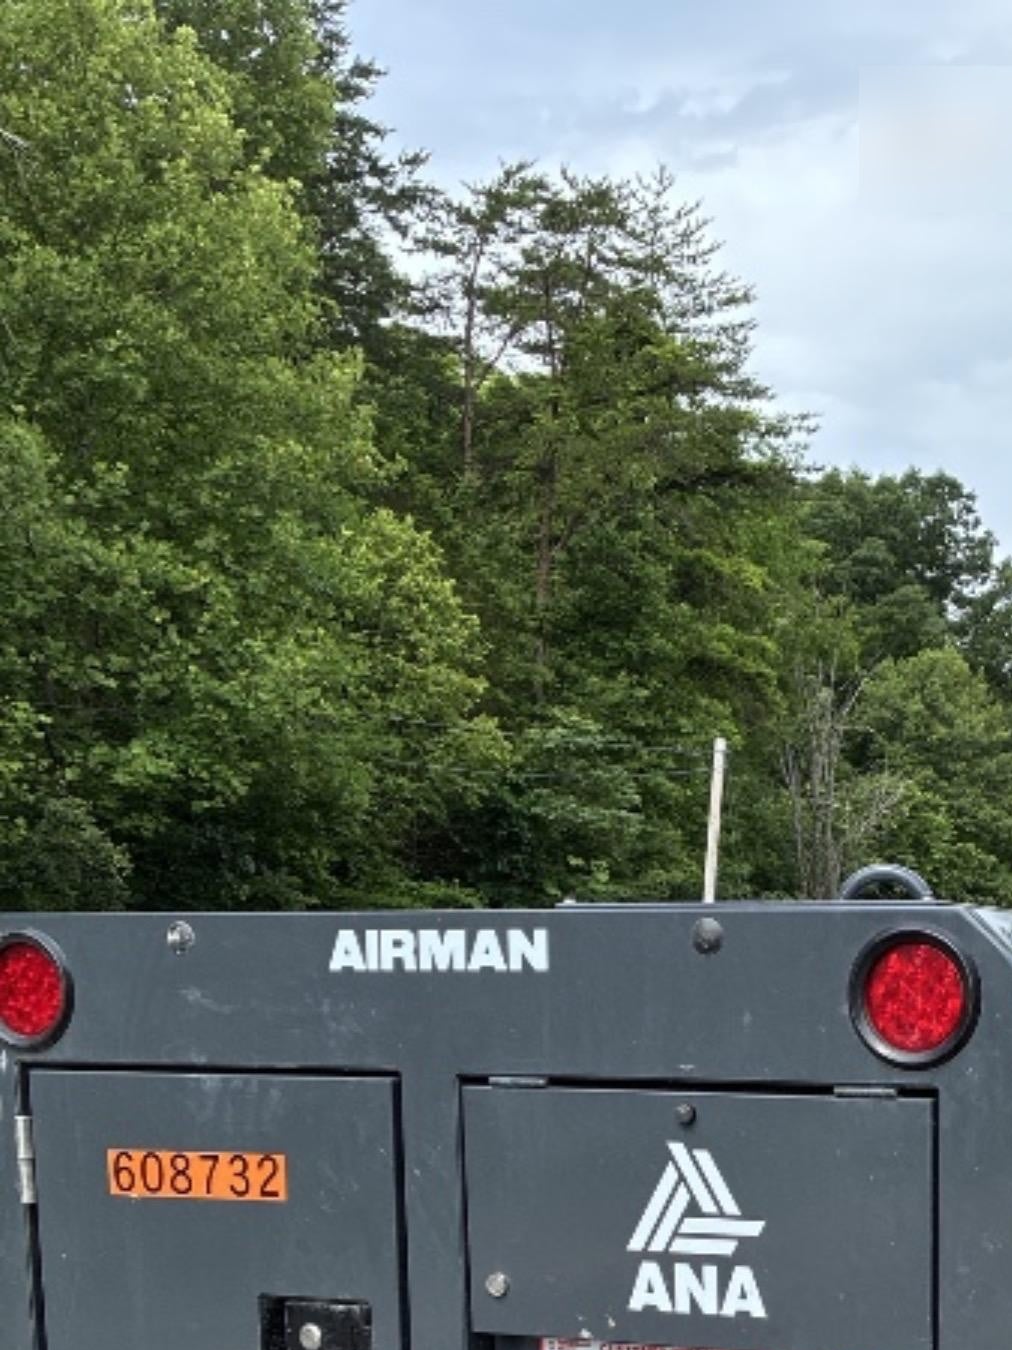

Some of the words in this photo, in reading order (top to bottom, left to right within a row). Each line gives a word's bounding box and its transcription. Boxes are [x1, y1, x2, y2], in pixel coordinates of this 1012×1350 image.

[328, 928, 549, 972] AIRMAN
[112, 1152, 281, 1197] 608732
[627, 1260, 768, 1318] ANA
